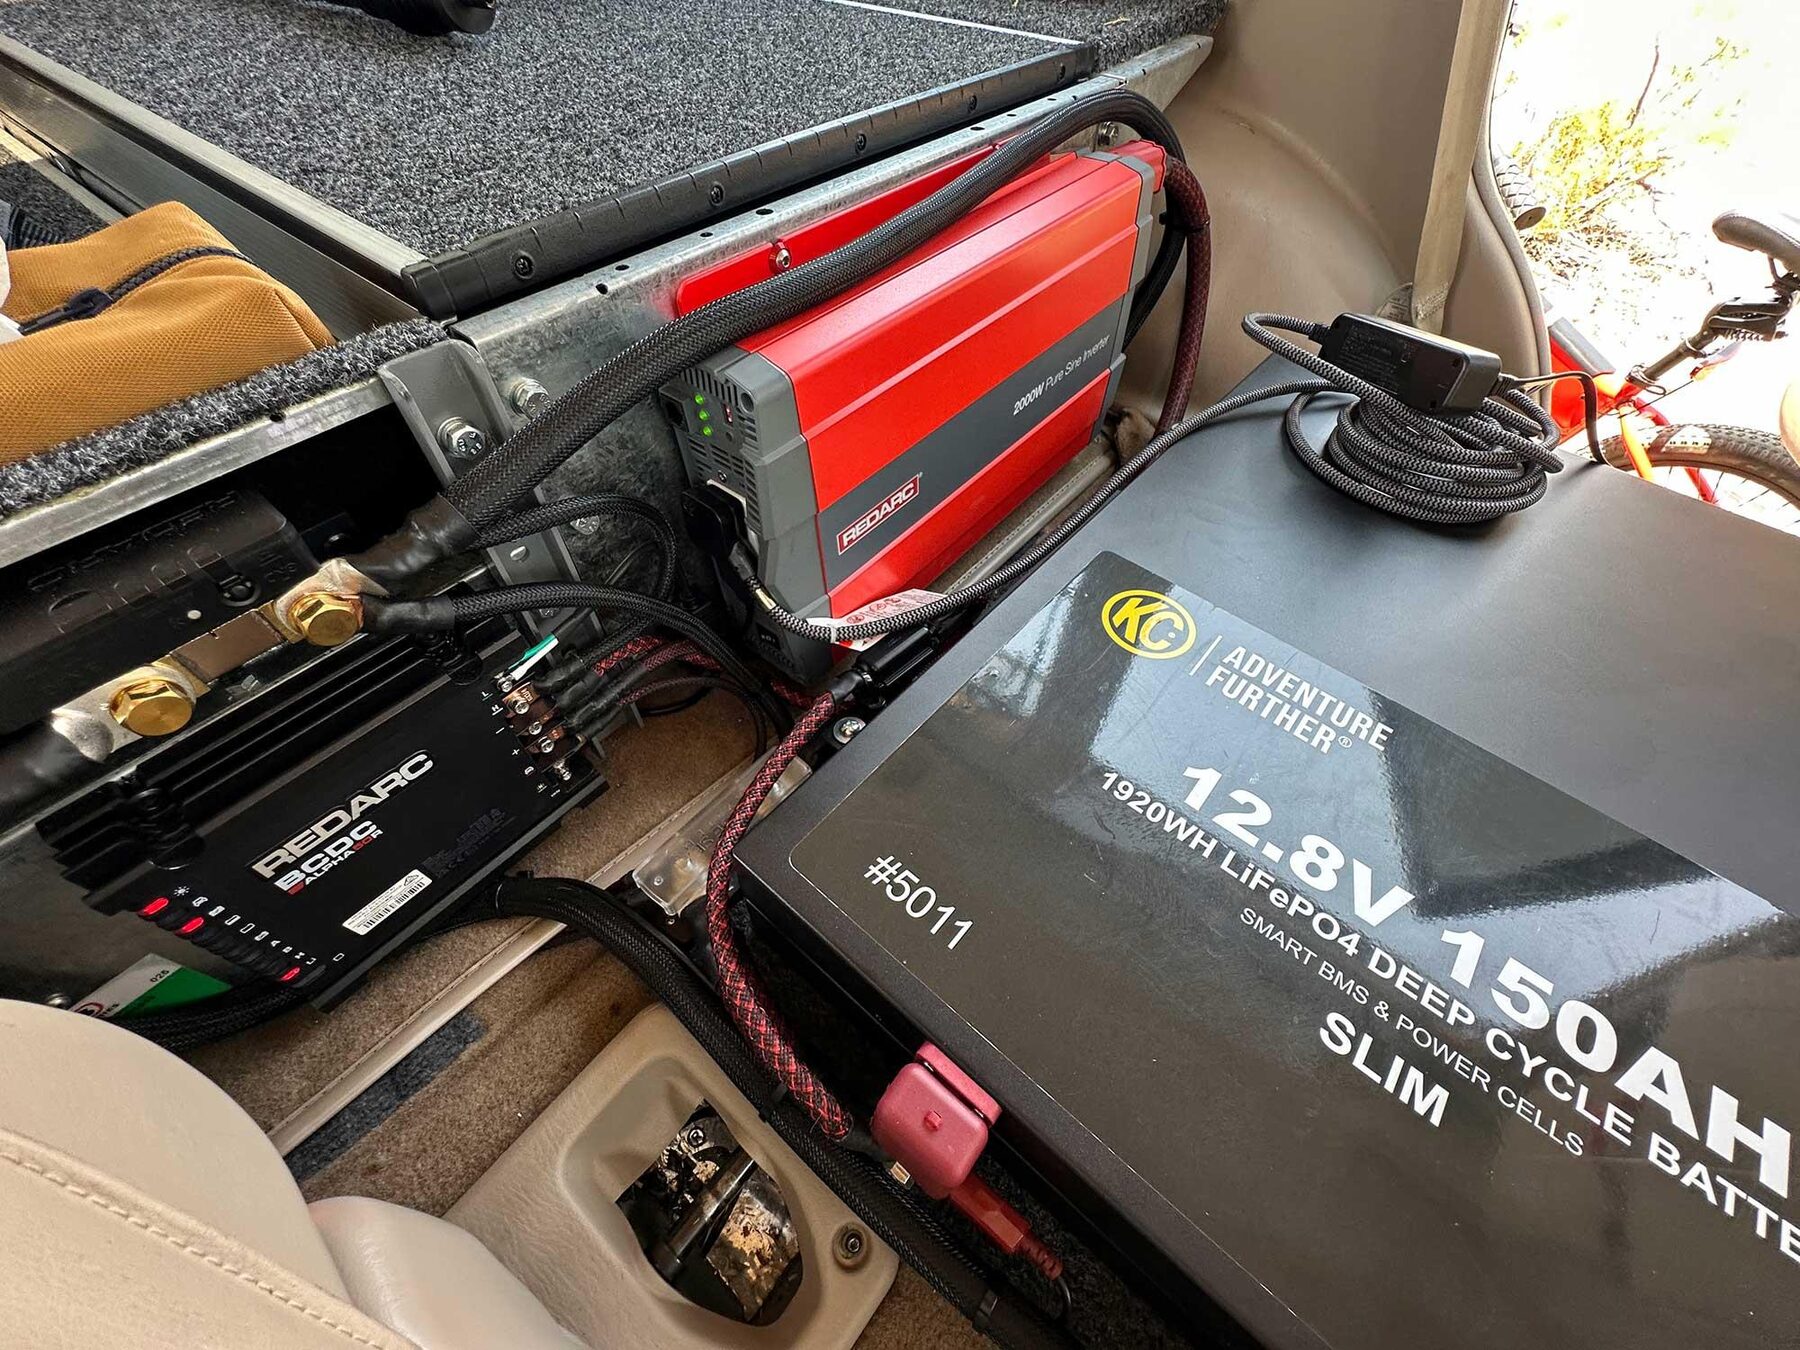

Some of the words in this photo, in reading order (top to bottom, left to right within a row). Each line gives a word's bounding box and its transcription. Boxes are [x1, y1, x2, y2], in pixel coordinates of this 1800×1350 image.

[1013, 382, 1046, 416] 2000W
[1045, 371, 1065, 391] Pure
[1064, 355, 1082, 376] Sine
[1082, 334, 1111, 365] Inverter
[842, 483, 915, 548] REDARC
[1112, 597, 1184, 651] KC
[1222, 645, 1395, 752] ADVENTURE
[251, 753, 434, 879] REDARC
[273, 820, 377, 892] BCDC
[863, 855, 974, 950] #5011
[1101, 772, 1219, 859] 1920WH
[1219, 849, 1362, 957] LiFePO4
[1367, 945, 1476, 1026] DEEP
[1485, 1028, 1635, 1147] CYCLE
[1648, 1131, 1800, 1265] BATTE
[1182, 765, 1416, 928] 12.8V
[1440, 929, 1791, 1200] 150AH
[1239, 907, 1318, 967] SMART
[1318, 960, 1370, 1004] BMS
[1373, 1000, 1390, 1022] &
[1395, 1013, 1492, 1093] POWER
[1497, 1085, 1585, 1157] CELLS
[1319, 1011, 1450, 1128] SLIM
